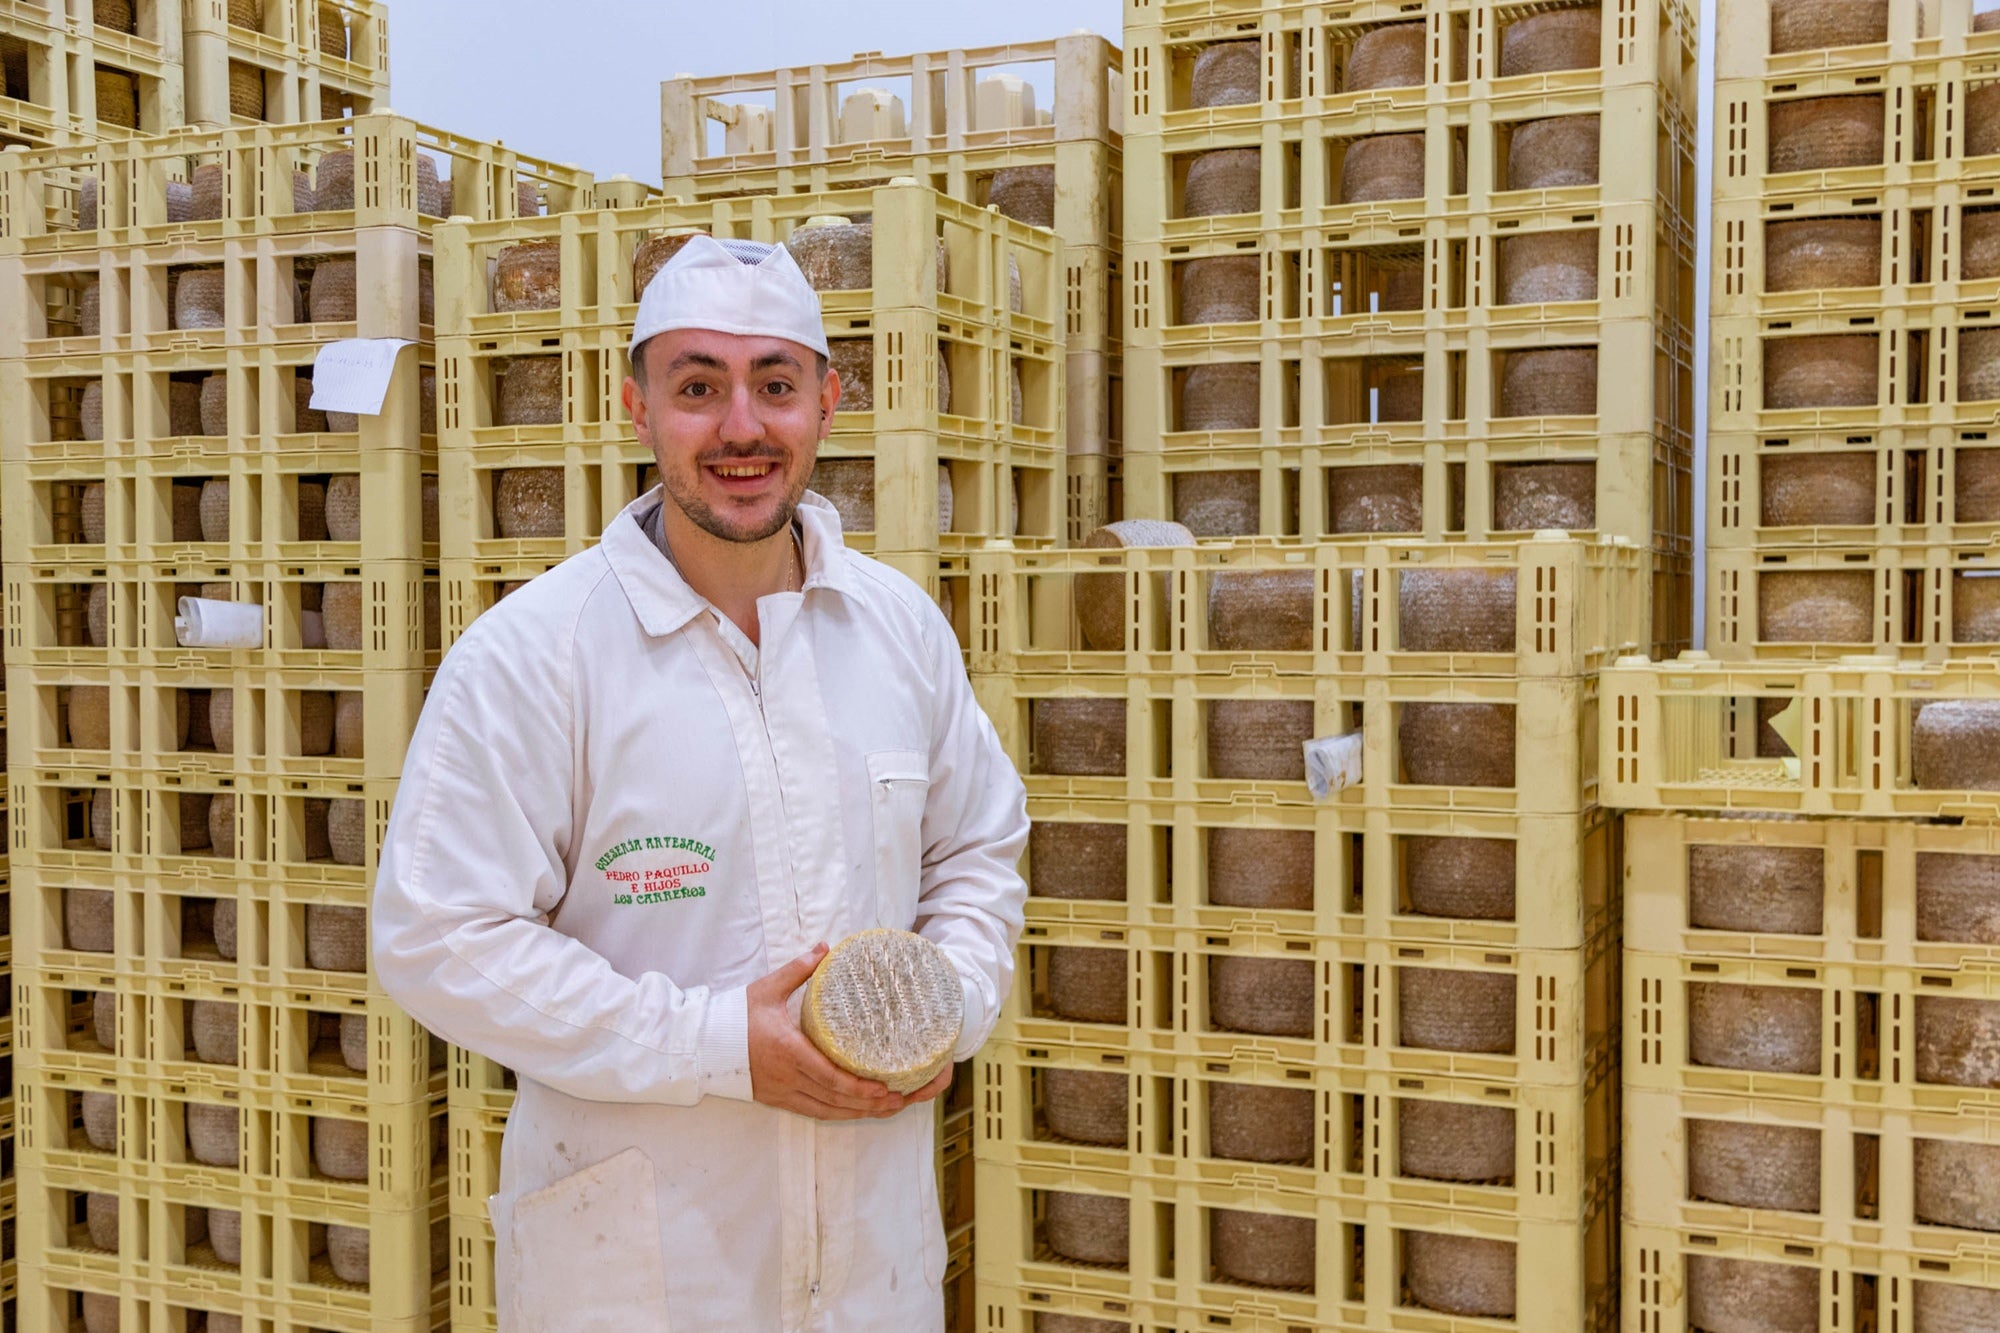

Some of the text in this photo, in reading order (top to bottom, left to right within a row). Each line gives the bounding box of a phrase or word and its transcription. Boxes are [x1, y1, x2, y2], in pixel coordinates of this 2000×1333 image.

[605, 862, 710, 882] PEDRO PAQUILLO
[631, 879, 682, 893] E HIJOS
[614, 893, 633, 905] LOS
